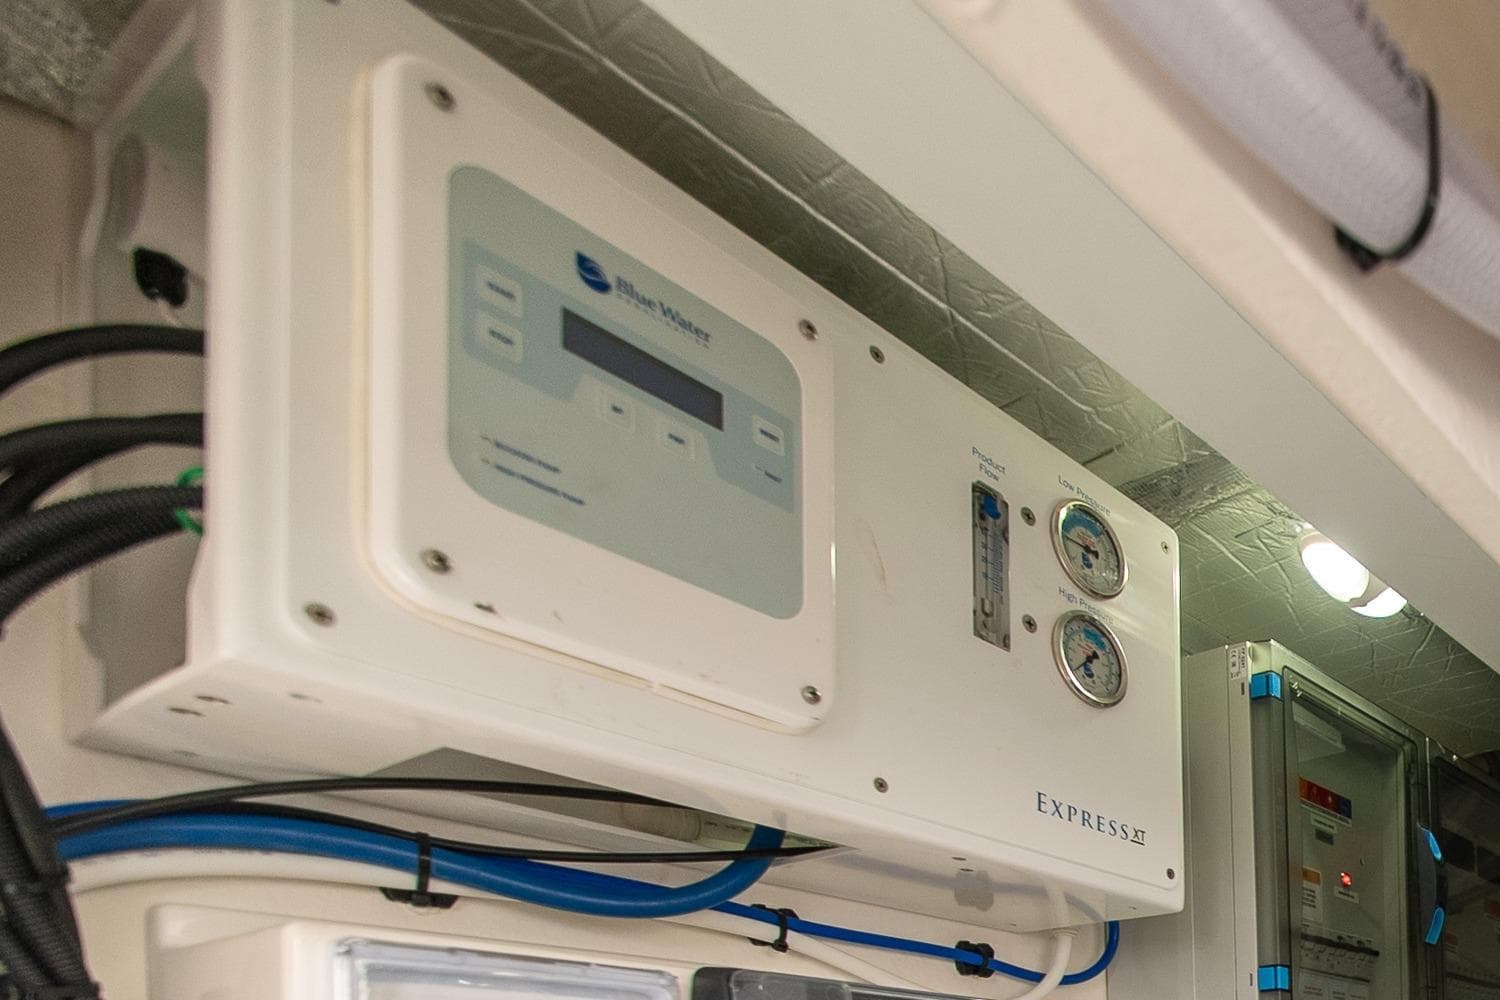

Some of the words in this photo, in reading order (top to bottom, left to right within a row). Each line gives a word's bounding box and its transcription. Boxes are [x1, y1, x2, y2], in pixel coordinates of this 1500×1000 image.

[616, 275, 656, 312] Blue
[658, 300, 711, 343] Water
[972, 446, 1006, 474] Product
[979, 463, 1000, 483] Flow
[1057, 475, 1075, 493] Low
[1076, 486, 1111, 517] Pressure
[1057, 586, 1077, 606] High
[1078, 598, 1114, 626] Pressure
